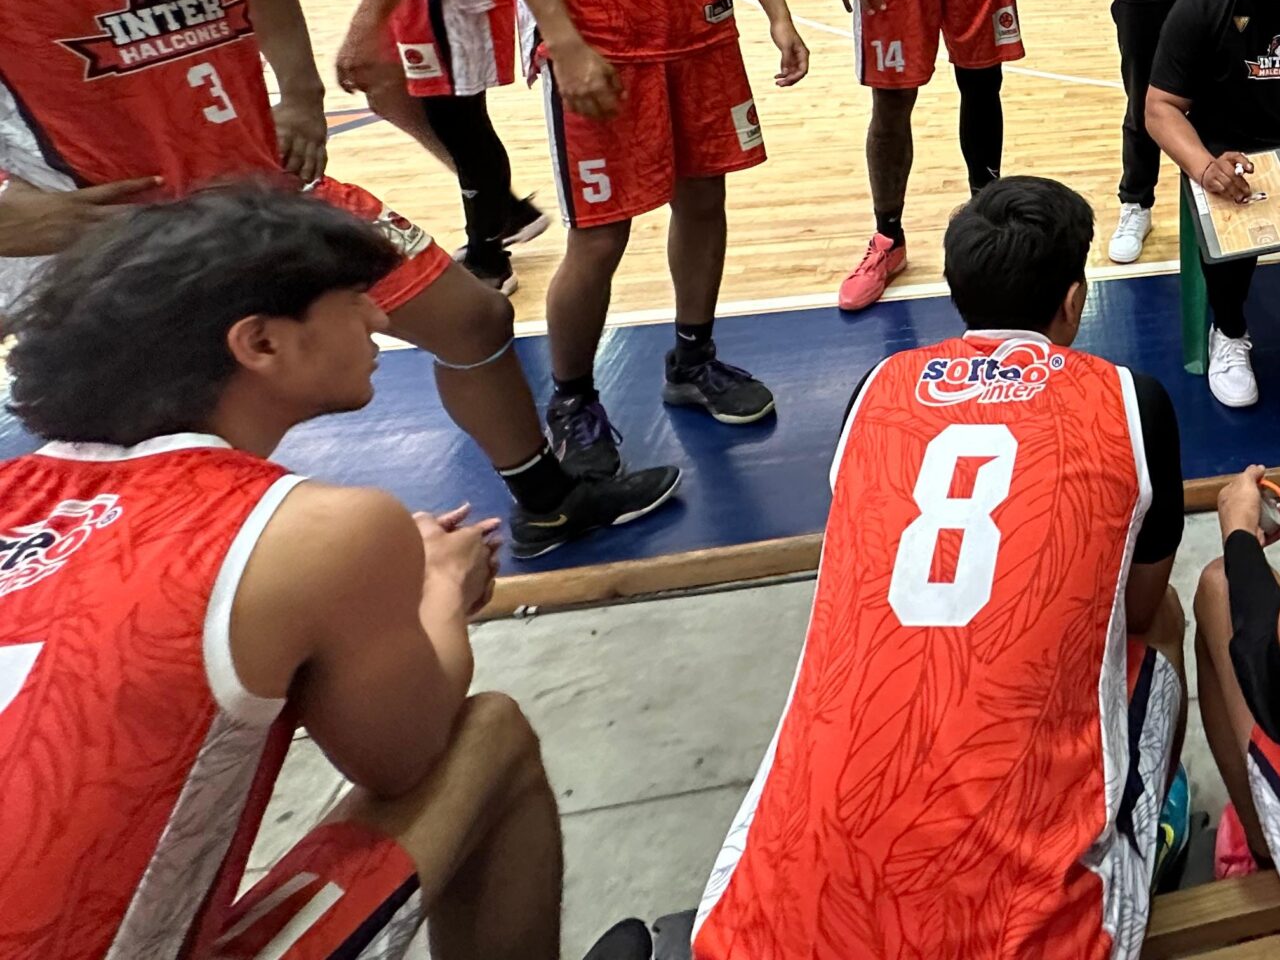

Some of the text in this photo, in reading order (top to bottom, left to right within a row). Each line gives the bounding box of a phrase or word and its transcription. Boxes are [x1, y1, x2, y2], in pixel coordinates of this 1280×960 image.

[119, 21, 230, 65] HALCONES
[871, 40, 906, 73] 14
[187, 62, 237, 124] 3
[578, 158, 612, 204] 5
[922, 358, 1049, 384] sorteo
[978, 383, 1045, 403] inter
[887, 424, 1018, 627] 8
